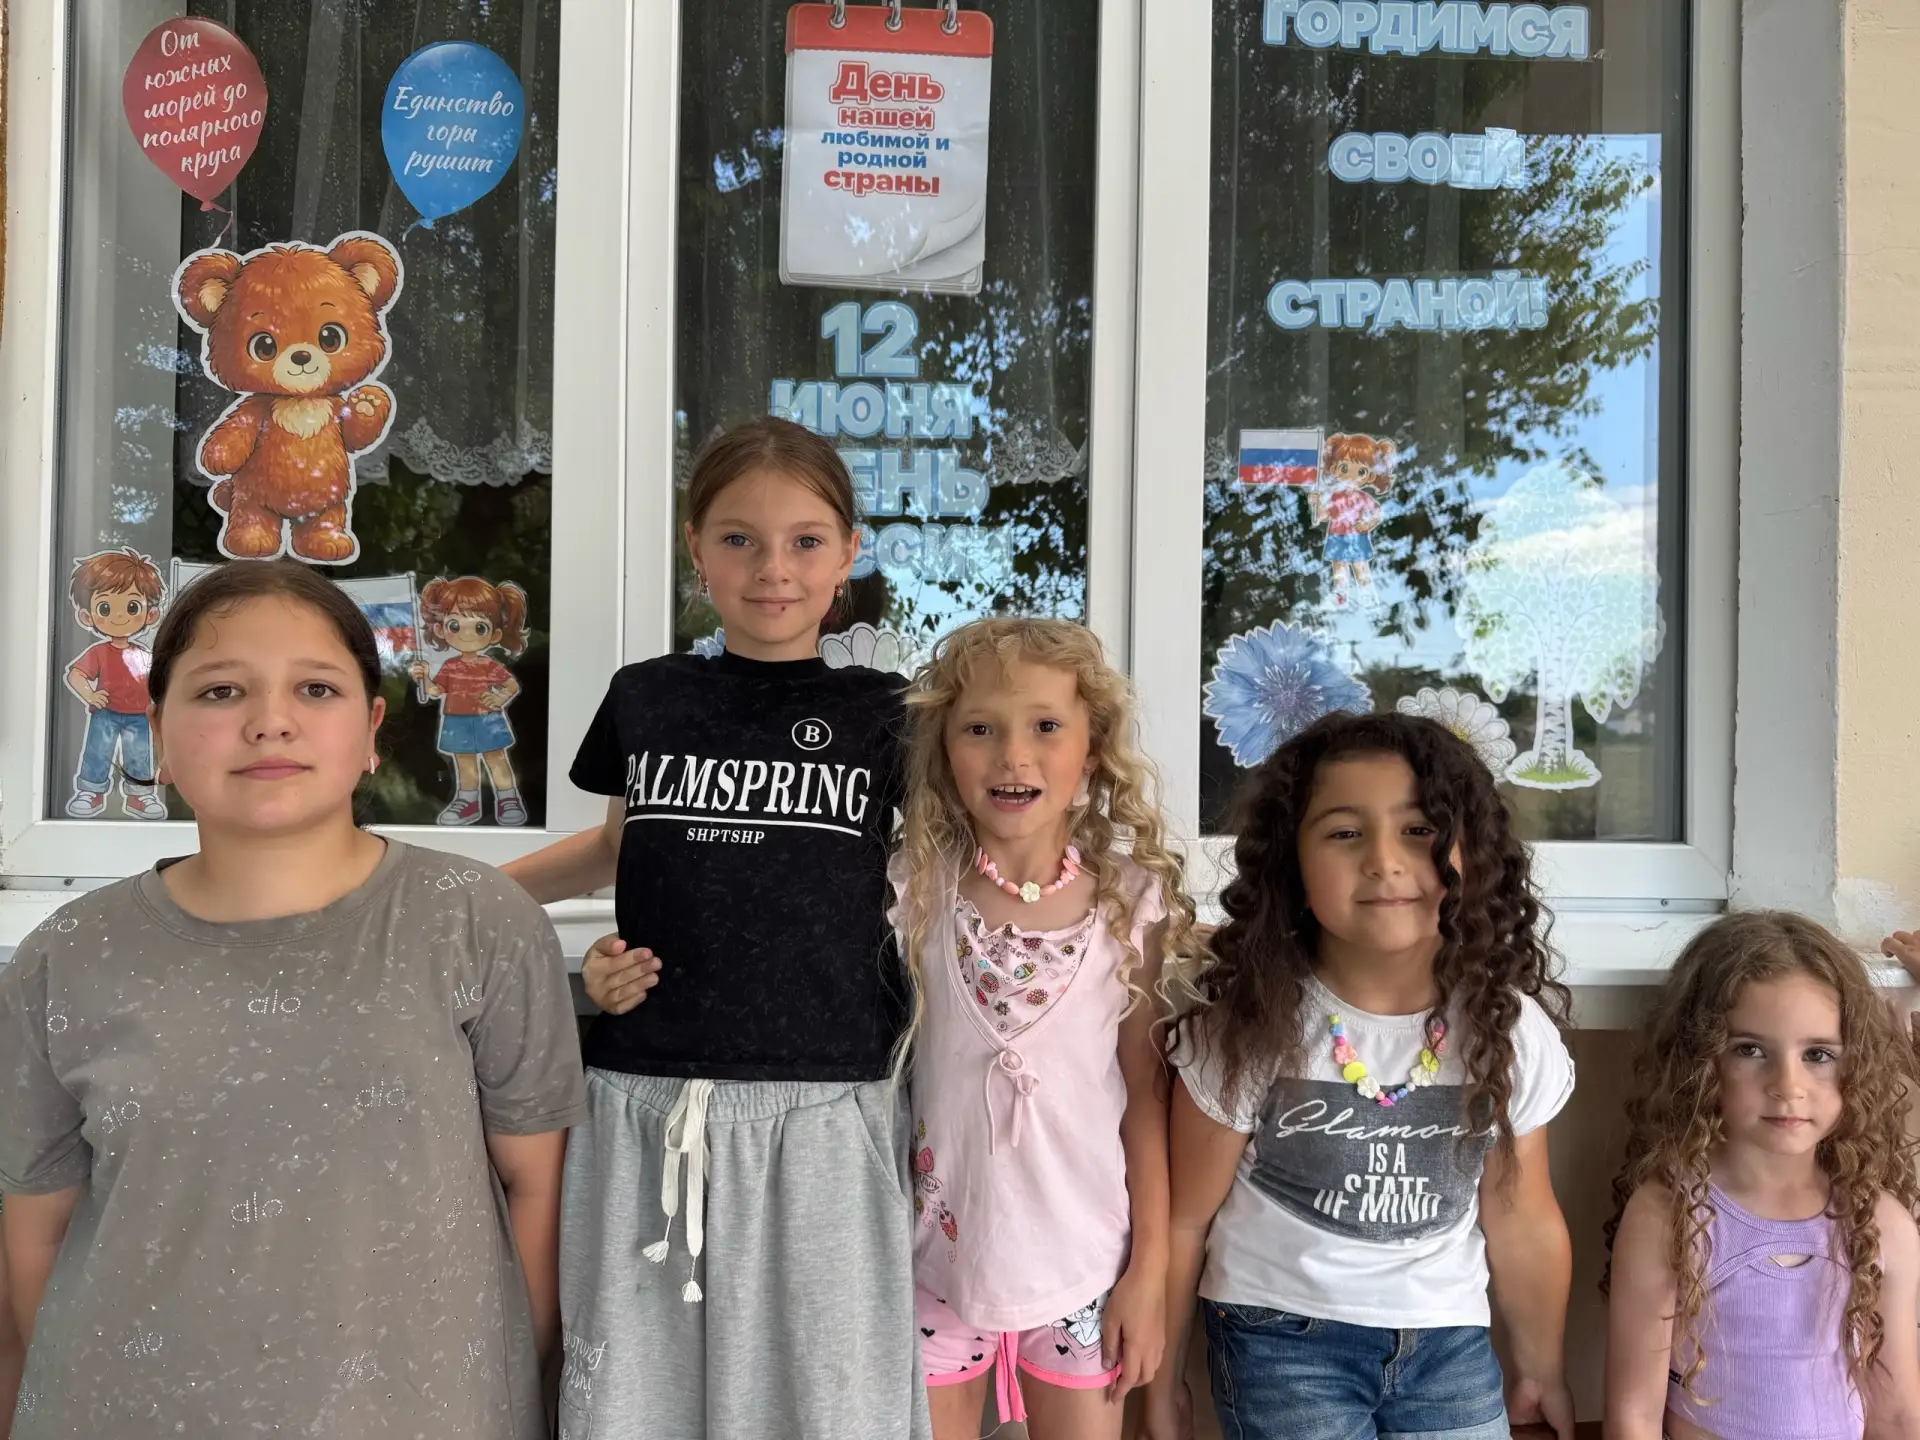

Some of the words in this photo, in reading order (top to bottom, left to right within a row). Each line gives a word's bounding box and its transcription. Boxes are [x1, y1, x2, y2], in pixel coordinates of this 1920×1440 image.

[159, 29, 200, 57] От
[1262, 1, 1589, 60] ГОРДИМСЯ
[144, 53, 232, 91] южных
[829, 61, 946, 105] День
[143, 84, 217, 121] морей
[223, 82, 248, 112] до
[393, 86, 515, 119] Единство
[142, 109, 263, 149] полярного
[837, 106, 936, 131] нашей
[427, 123, 478, 151] горы
[821, 130, 931, 150] любимой
[936, 136, 950, 151] и
[180, 143, 242, 180] круга
[404, 147, 496, 177] рушит
[837, 150, 928, 169] родной
[823, 169, 941, 198] страны
[1267, 269, 1549, 331] СТРАНОЙ!
[820, 300, 920, 378] 12
[771, 378, 974, 440] ИЮНЯ
[837, 448, 991, 518] ЕНЬ
[802, 724, 821, 743] B
[624, 750, 871, 825] PALMSPRING
[686, 827, 765, 845] SHPTSHP
[436, 867, 482, 892] alo
[247, 989, 302, 1015] alo
[1368, 1142, 1389, 1173] IS
[1392, 1142, 1407, 1174] A
[230, 1191, 284, 1223] alo
